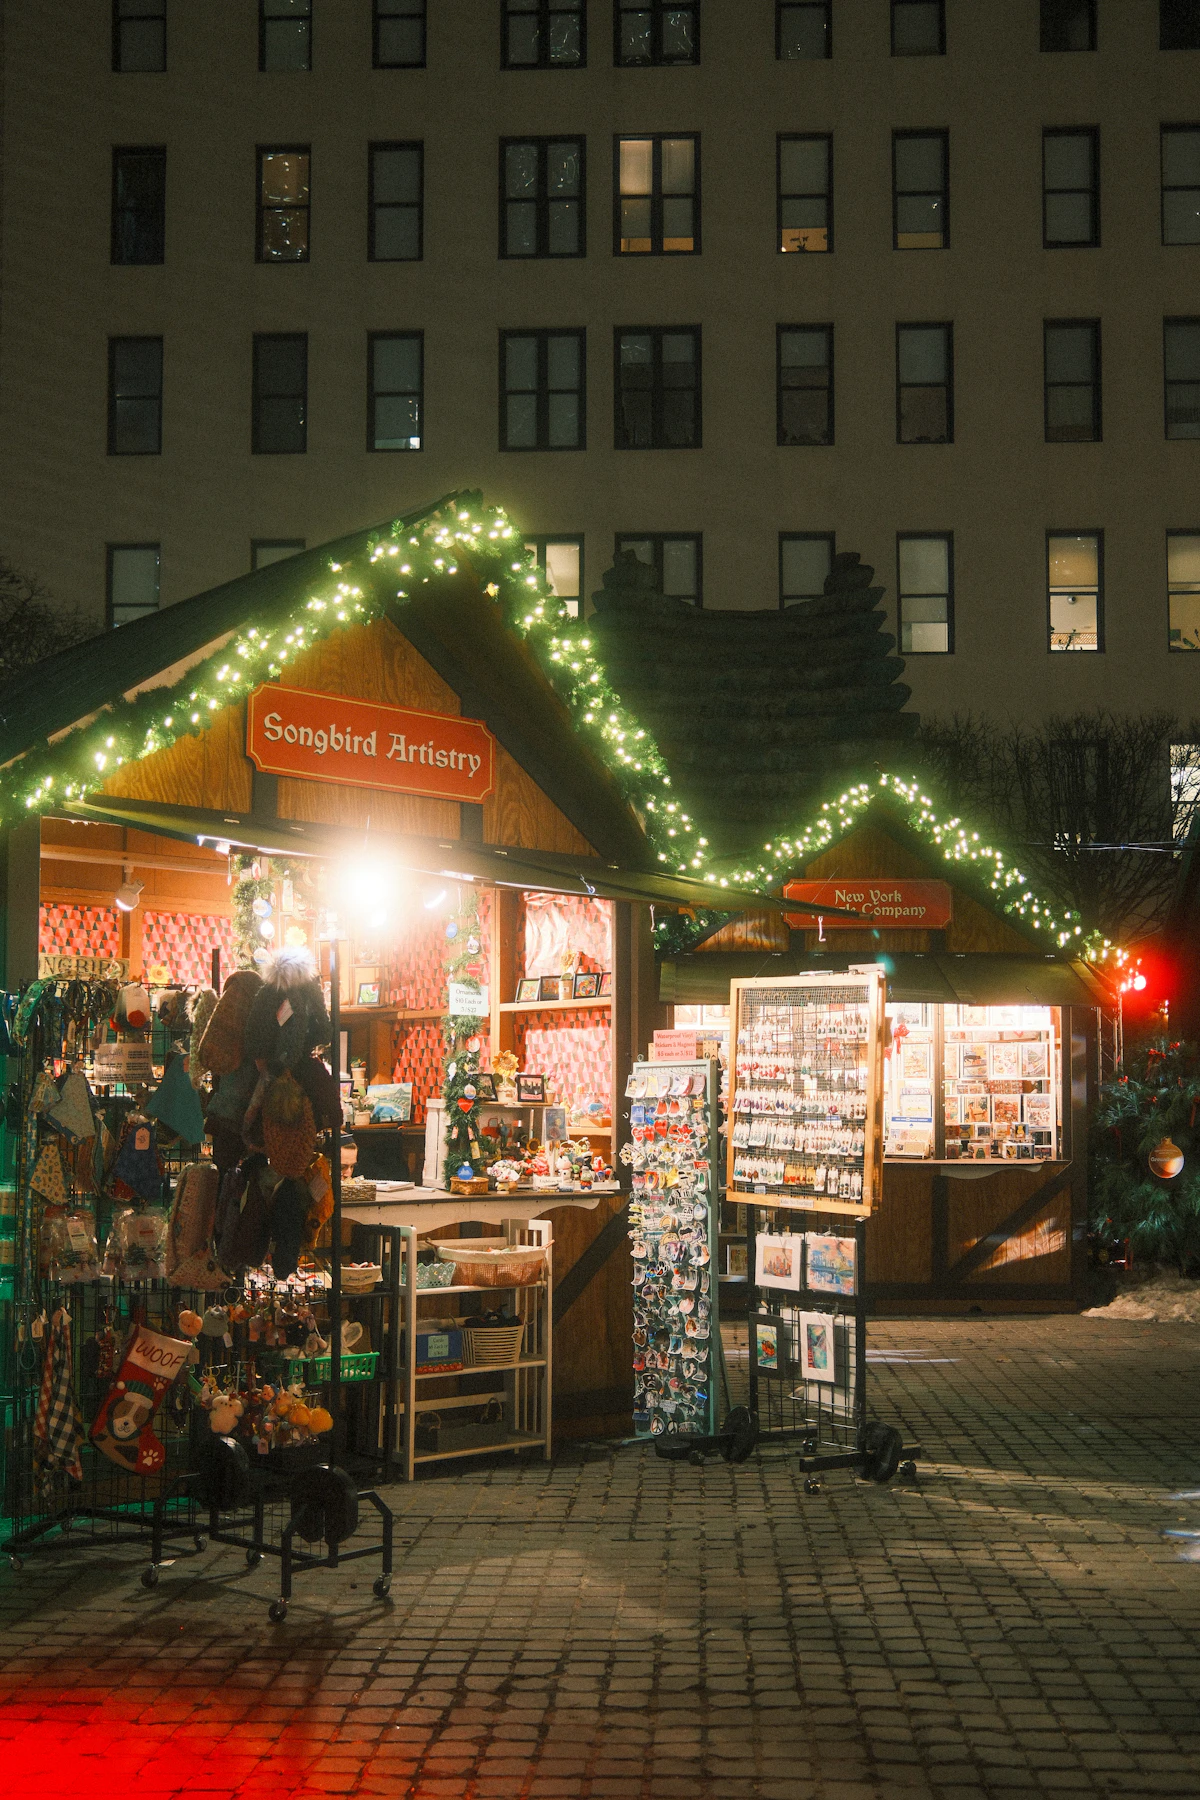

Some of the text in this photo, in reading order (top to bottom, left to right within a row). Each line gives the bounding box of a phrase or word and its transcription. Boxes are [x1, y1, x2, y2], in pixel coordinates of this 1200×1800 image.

[264, 712, 481, 778] Songbird Artistry
[835, 890, 902, 905] New York
[862, 903, 926, 918] Company
[136, 1341, 185, 1368] WOOF
